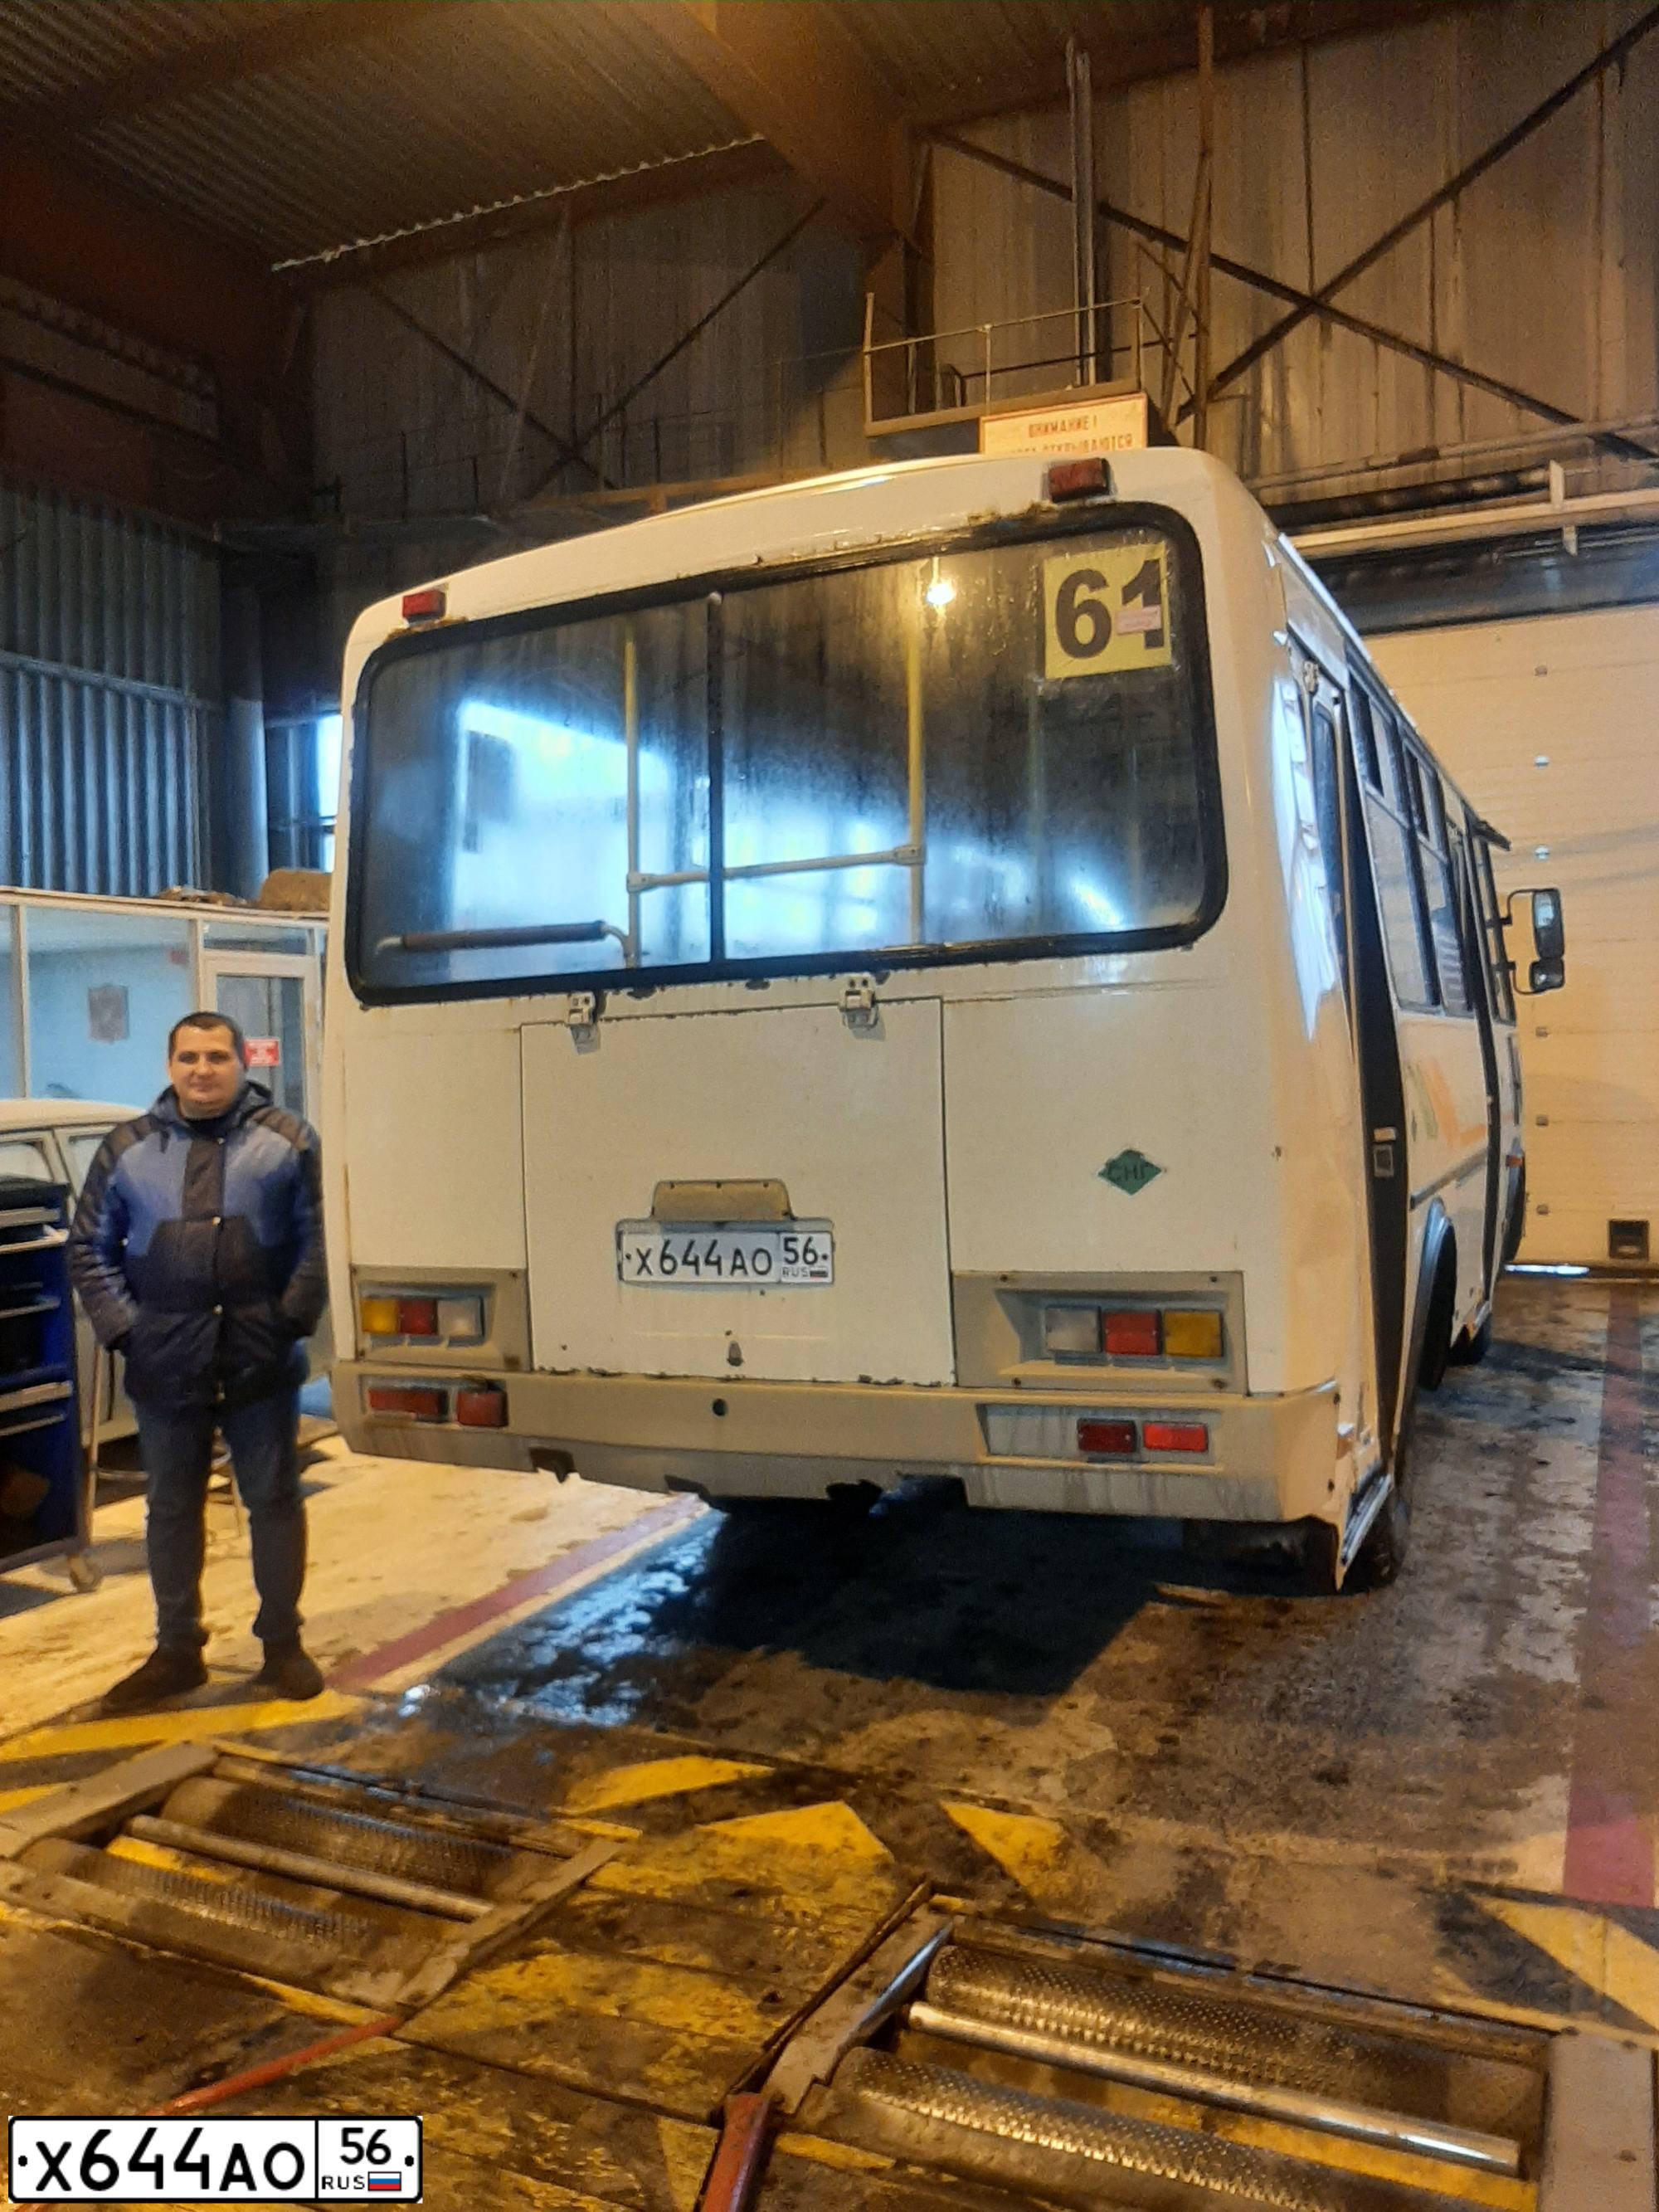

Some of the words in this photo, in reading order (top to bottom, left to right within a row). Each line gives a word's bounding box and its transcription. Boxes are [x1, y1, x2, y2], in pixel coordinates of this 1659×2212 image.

[1055, 558, 1165, 659] 61
[635, 1238, 773, 1276] Х644АО
[783, 1237, 818, 1265] 56
[782, 1267, 809, 1278] RUS
